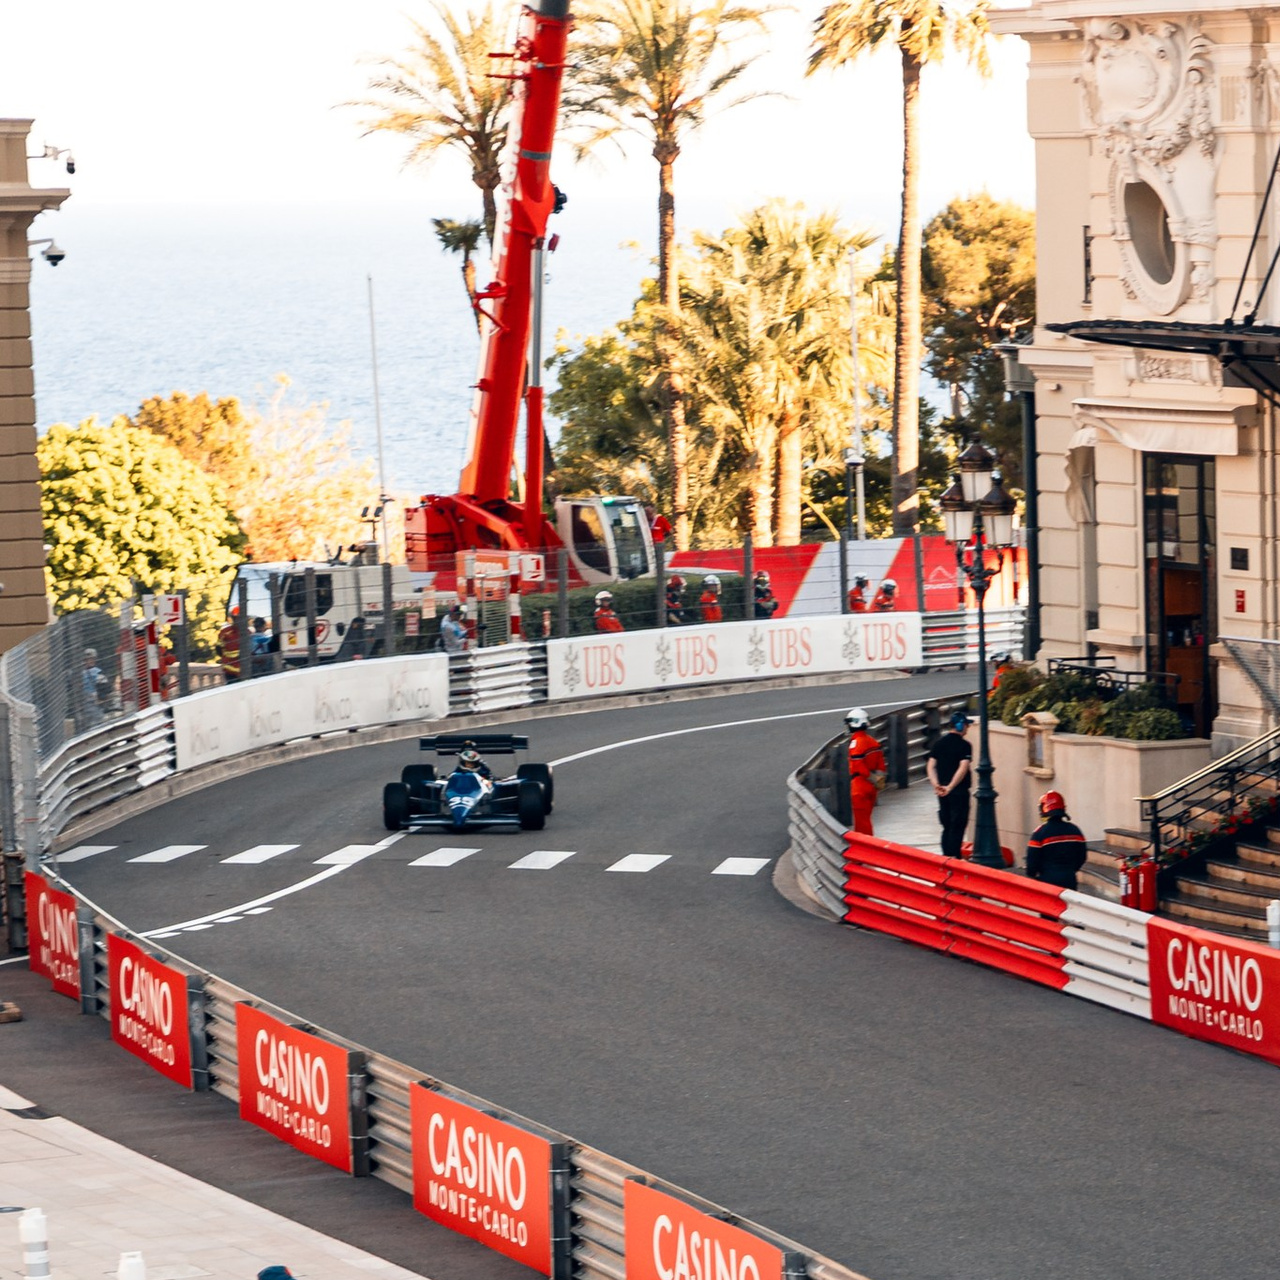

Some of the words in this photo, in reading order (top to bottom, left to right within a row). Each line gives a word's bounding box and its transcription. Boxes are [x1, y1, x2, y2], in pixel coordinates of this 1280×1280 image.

[583, 643, 625, 689] UBS
[675, 634, 718, 678] UBS
[768, 626, 812, 669] UBS
[863, 622, 906, 663] UBS
[119, 956, 173, 1036] CASINO
[1167, 936, 1263, 1012] CASINO
[255, 1029, 329, 1115] CASINO
[428, 1112, 527, 1211] CASINO
